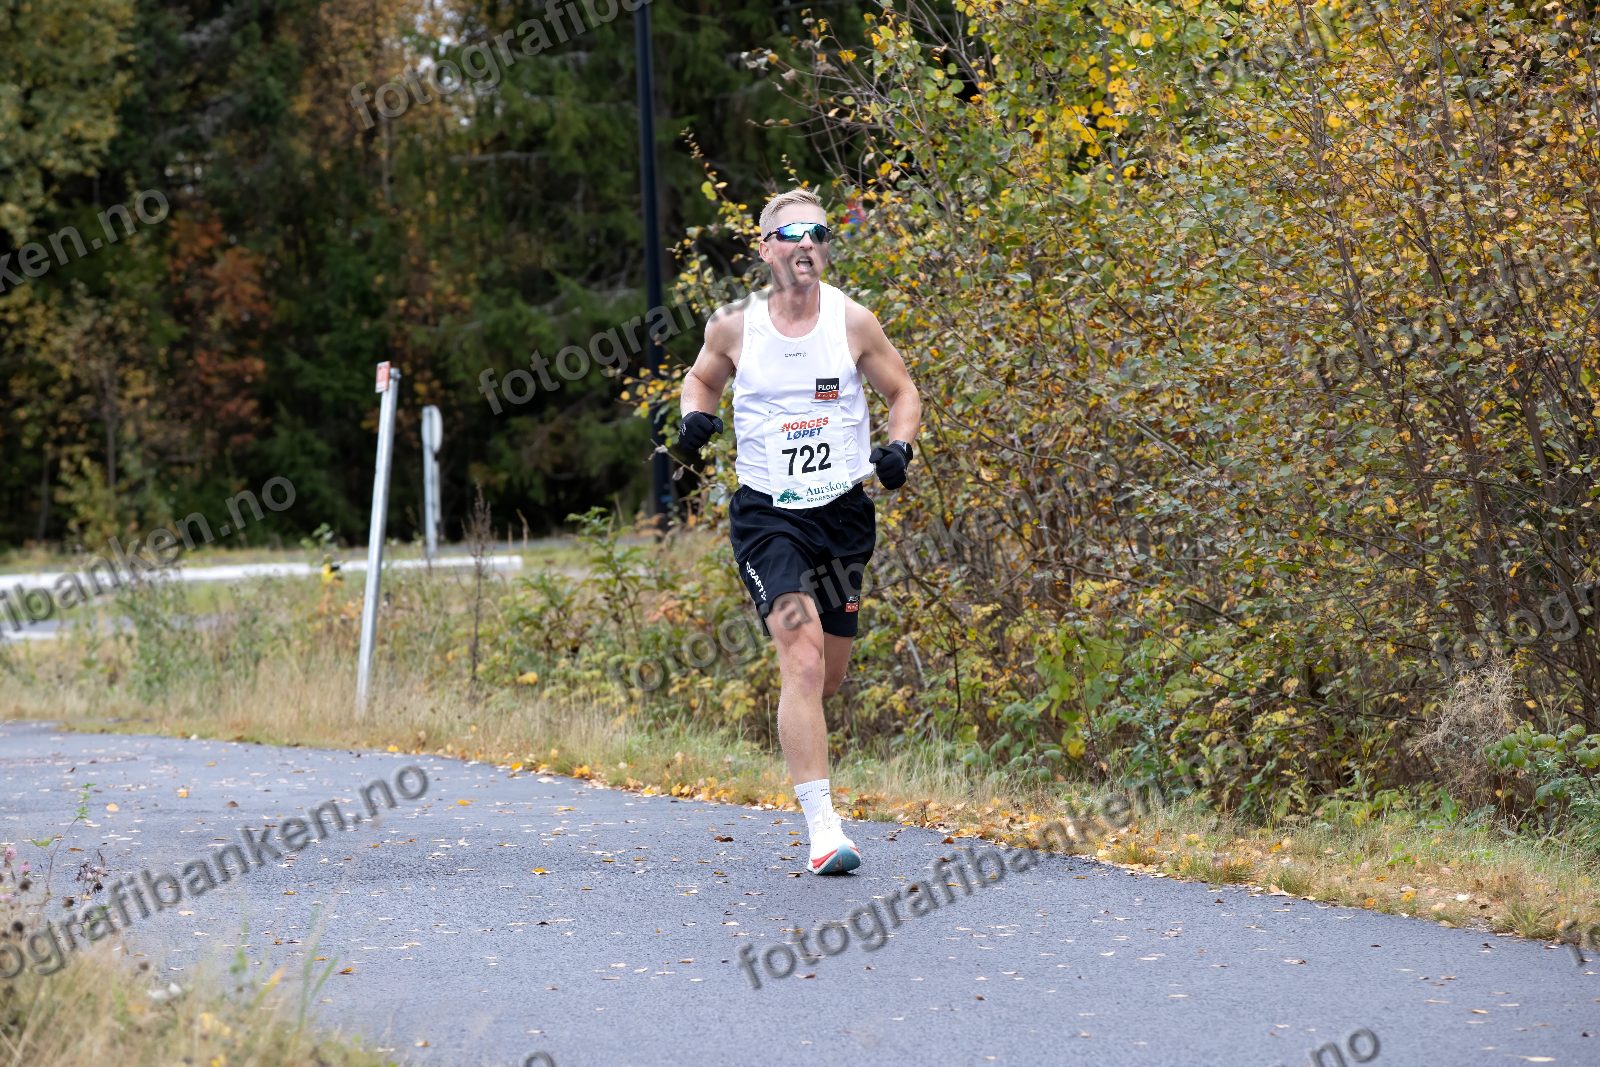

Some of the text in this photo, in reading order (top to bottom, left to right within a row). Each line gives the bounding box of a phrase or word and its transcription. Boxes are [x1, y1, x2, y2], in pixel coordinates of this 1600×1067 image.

[817, 383, 838, 391] FLOW
[781, 416, 829, 433] NORGES
[786, 427, 823, 440] LØPET
[781, 442, 832, 476] 722
[806, 481, 849, 496] Aurskog
